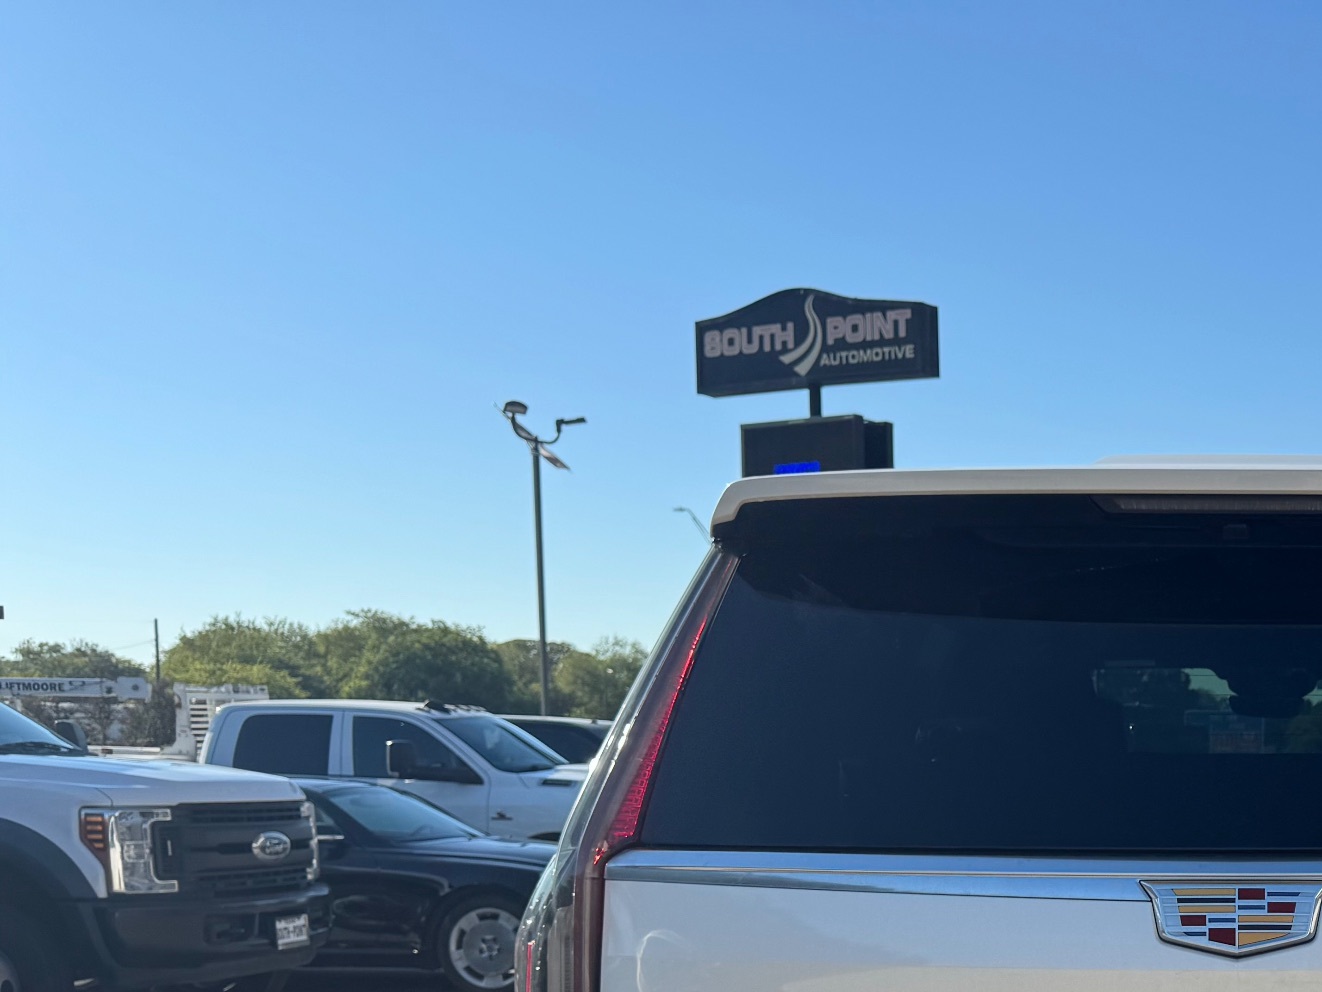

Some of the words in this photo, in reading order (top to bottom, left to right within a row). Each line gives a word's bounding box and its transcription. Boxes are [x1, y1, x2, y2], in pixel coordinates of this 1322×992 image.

[704, 321, 794, 358] SOUTH
[826, 309, 911, 345] POINT
[819, 344, 915, 367] AUTOMOTIVE
